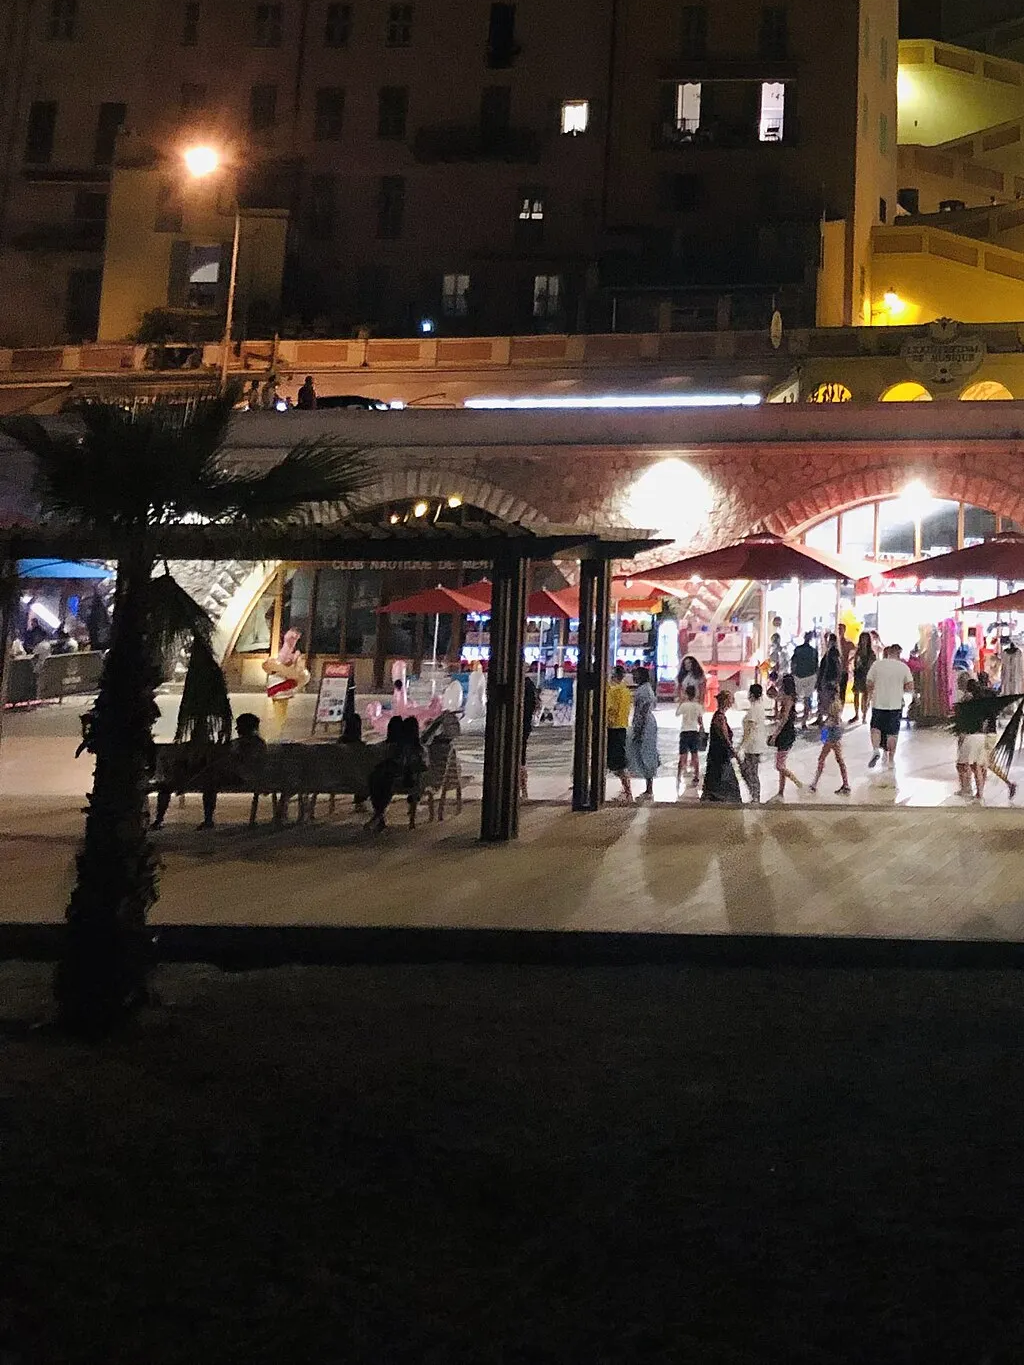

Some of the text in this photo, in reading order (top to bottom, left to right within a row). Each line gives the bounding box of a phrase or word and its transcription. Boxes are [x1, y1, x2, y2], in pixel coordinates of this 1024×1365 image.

[930, 353, 975, 362] MUSIQUE
[332, 560, 364, 570] CLUB
[369, 560, 432, 570] NAUTIQUE
[438, 560, 456, 570] DE
